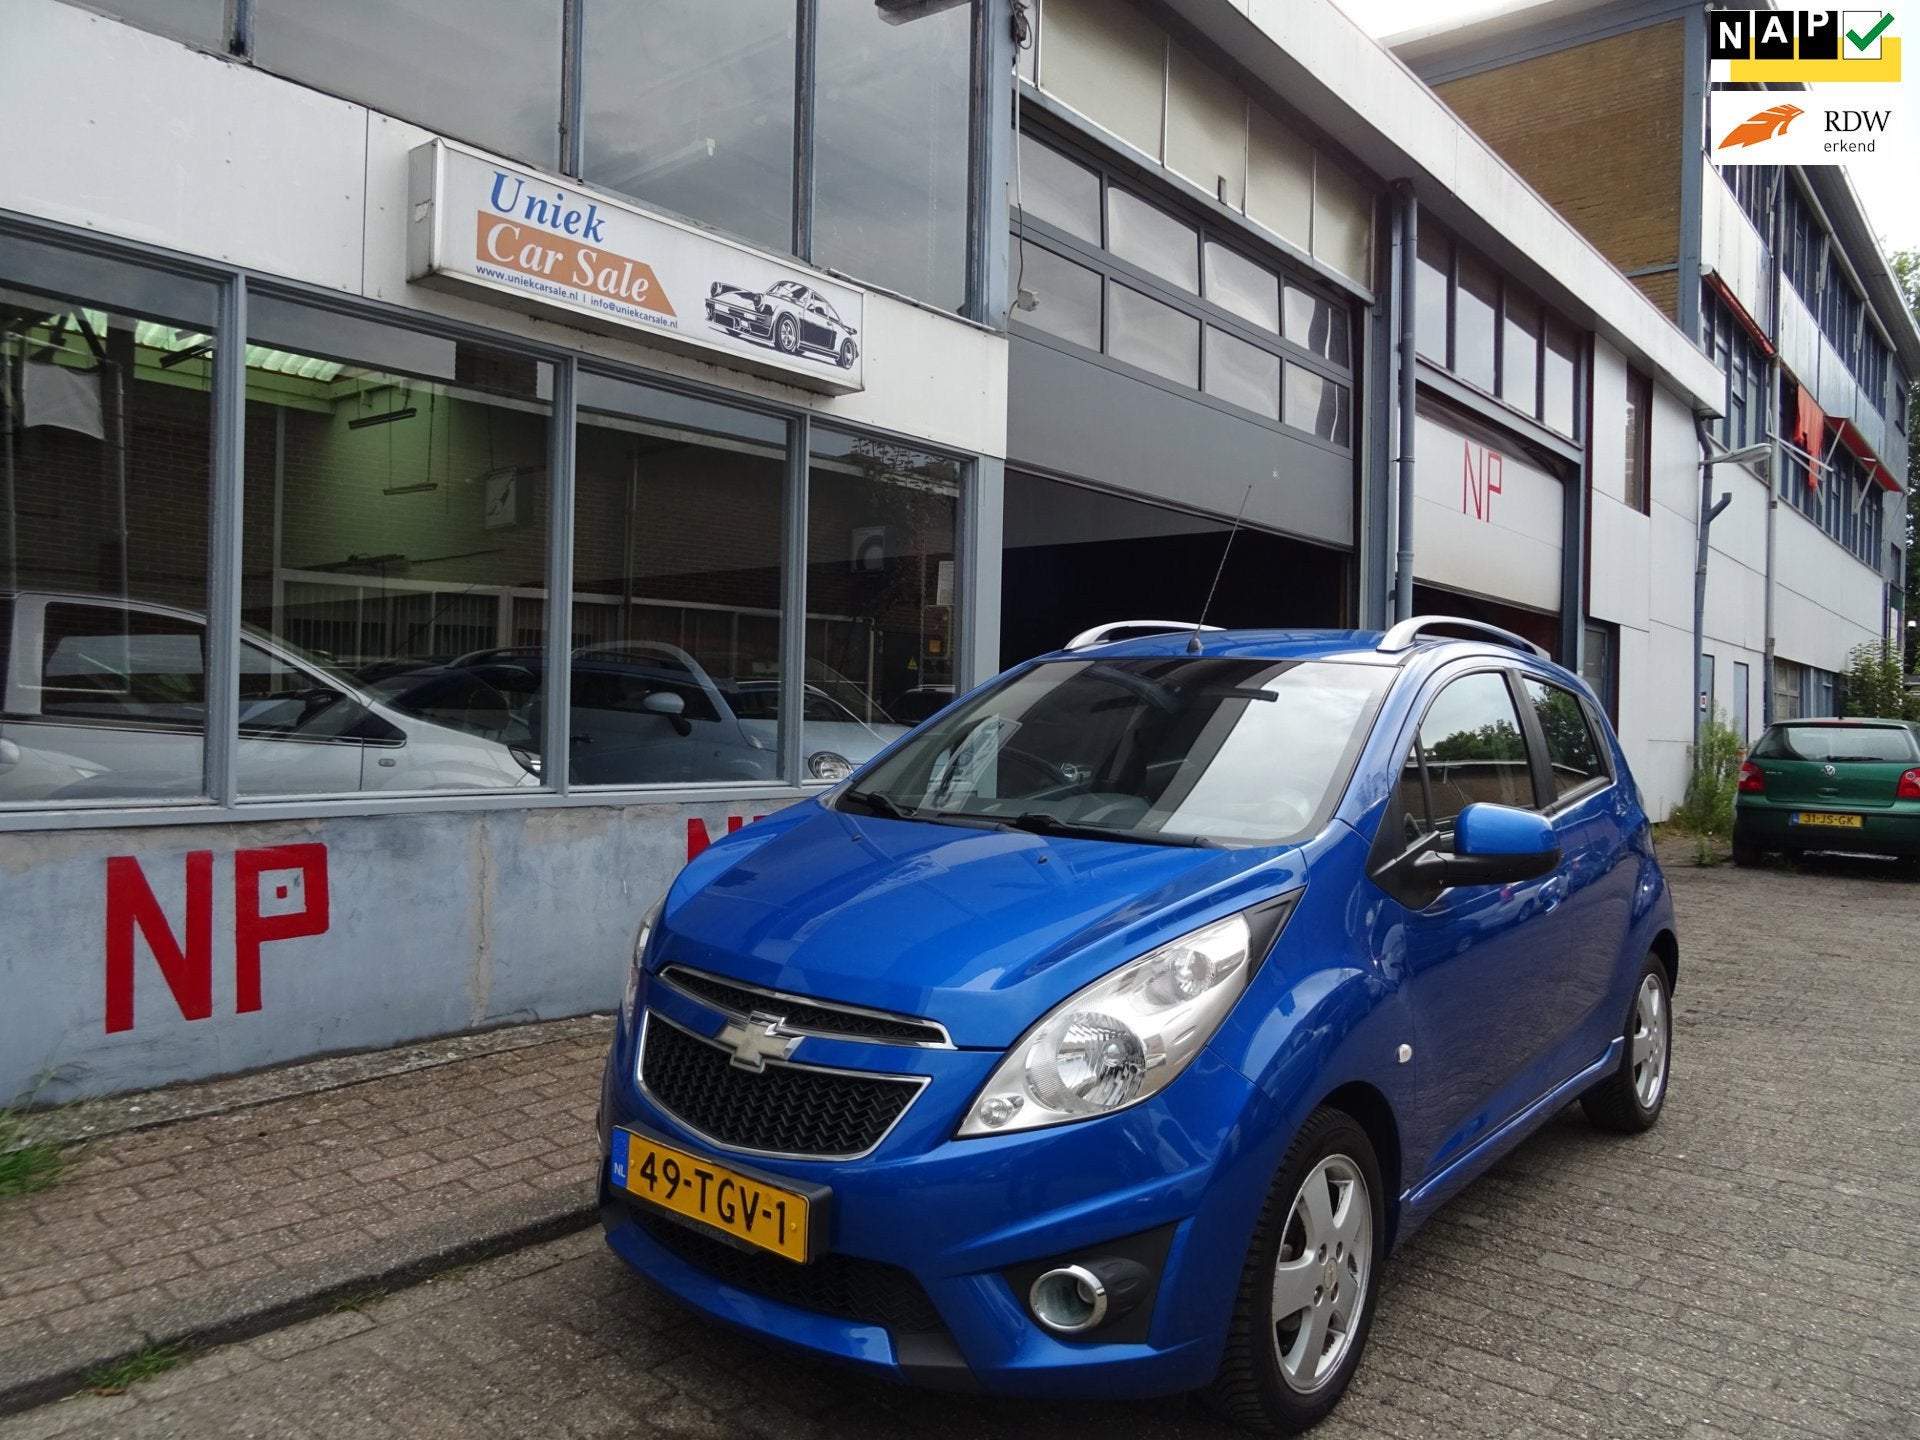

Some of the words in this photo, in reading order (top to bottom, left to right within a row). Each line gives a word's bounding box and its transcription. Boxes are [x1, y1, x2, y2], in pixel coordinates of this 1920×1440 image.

[490, 171, 606, 243] Uniek
[476, 265, 578, 301] www.uniekcarsale.nl
[590, 296, 678, 328] info@uniekcarsale.nl
[486, 223, 563, 276] Car
[572, 248, 649, 302] Sale
[1463, 440, 1503, 523] NP
[1804, 813, 1854, 825] 31-JS-GK
[104, 842, 329, 1034] NP
[614, 1161, 627, 1179] NL
[639, 1151, 787, 1245] 49-TGV-1
